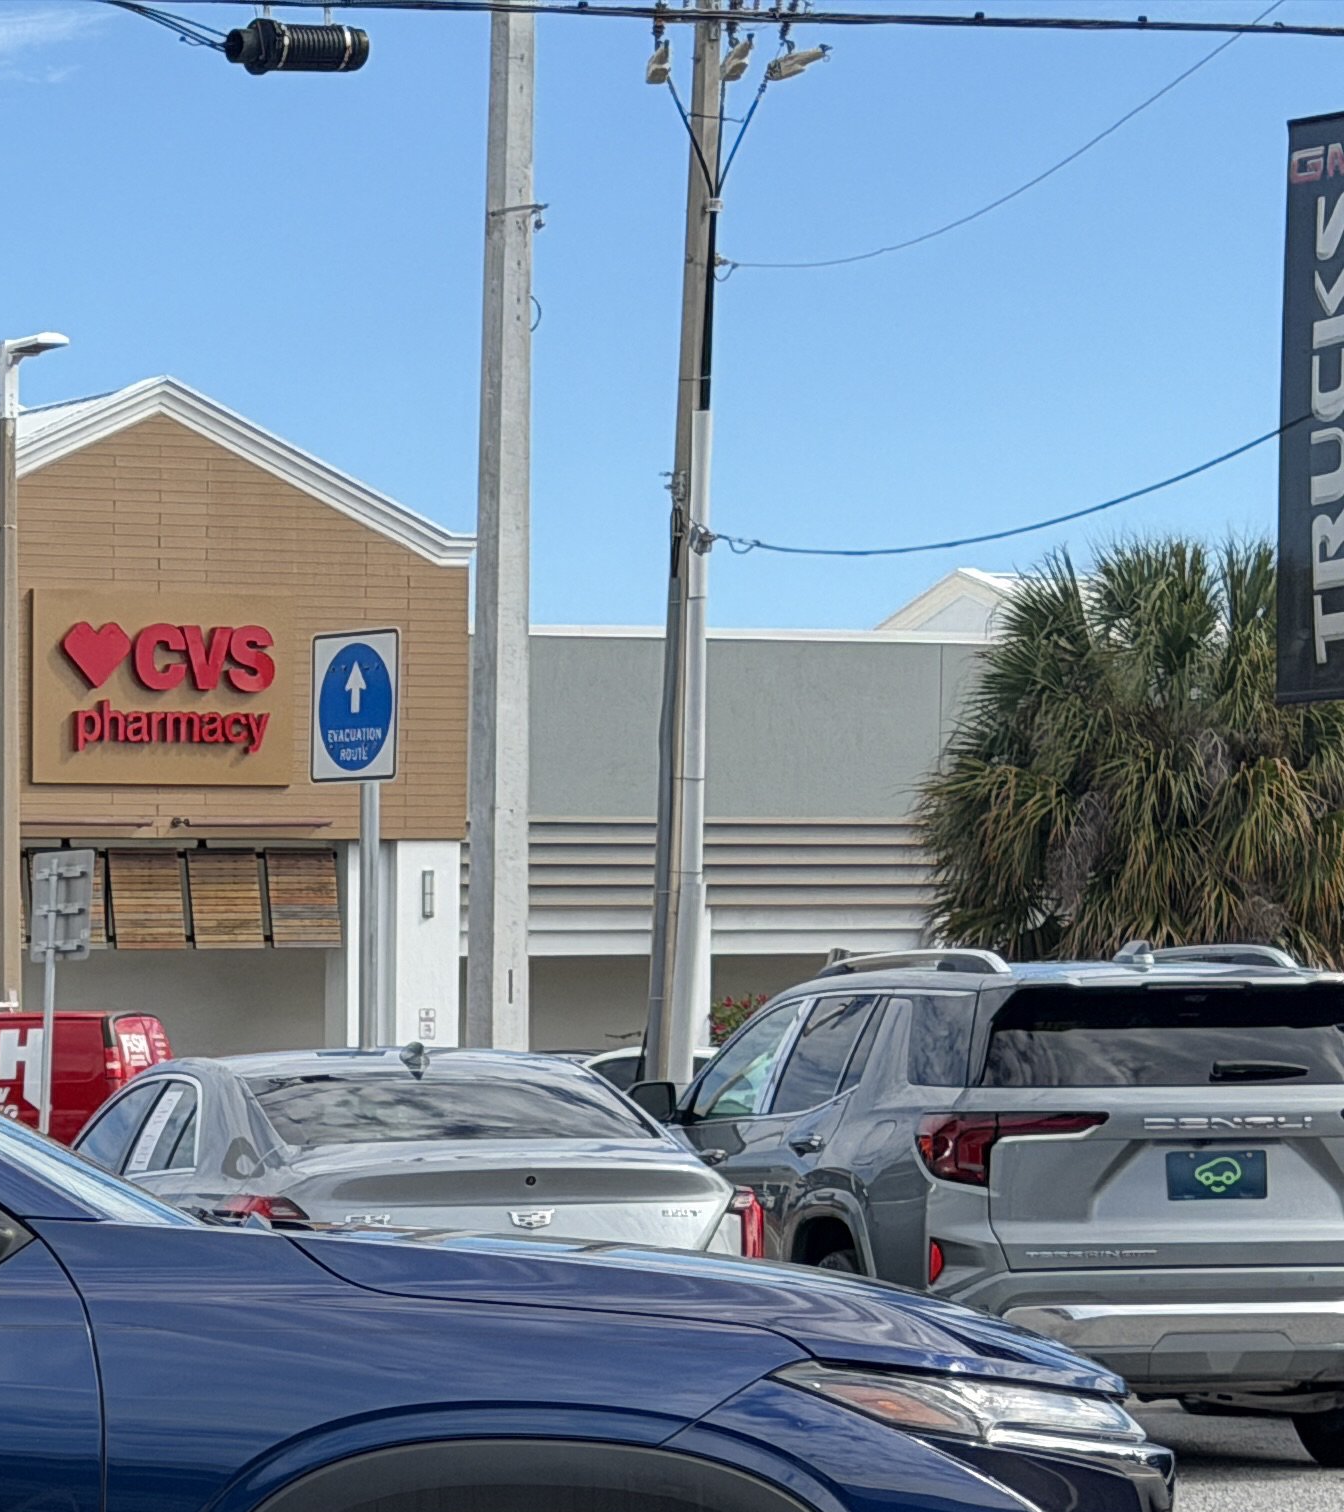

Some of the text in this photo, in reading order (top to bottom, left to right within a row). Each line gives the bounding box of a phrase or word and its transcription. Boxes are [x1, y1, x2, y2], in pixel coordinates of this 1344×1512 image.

[132, 623, 275, 692] CVS
[74, 699, 271, 753] pharmacy
[327, 727, 382, 743] EVACUATION
[339, 746, 369, 761] ROUTE
